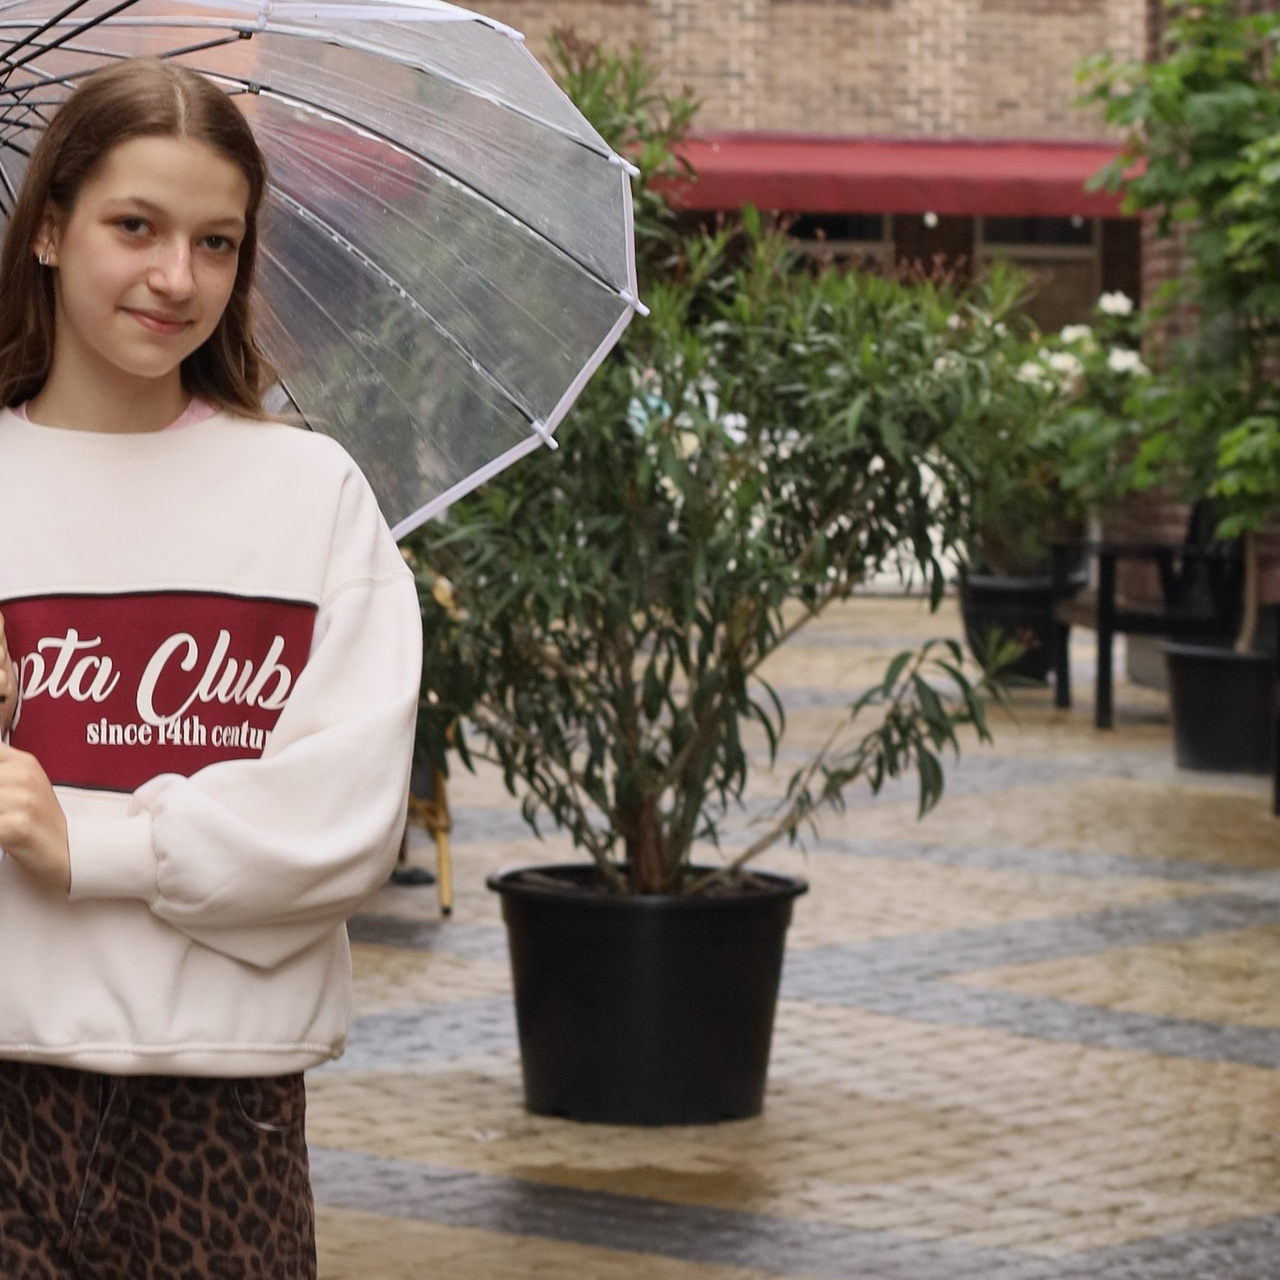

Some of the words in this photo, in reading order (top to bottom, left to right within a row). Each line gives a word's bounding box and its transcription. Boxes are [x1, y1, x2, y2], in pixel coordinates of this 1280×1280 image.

[12, 628, 121, 729] pta
[136, 629, 291, 727] Club
[86, 717, 152, 746] since
[157, 715, 207, 746] 14th
